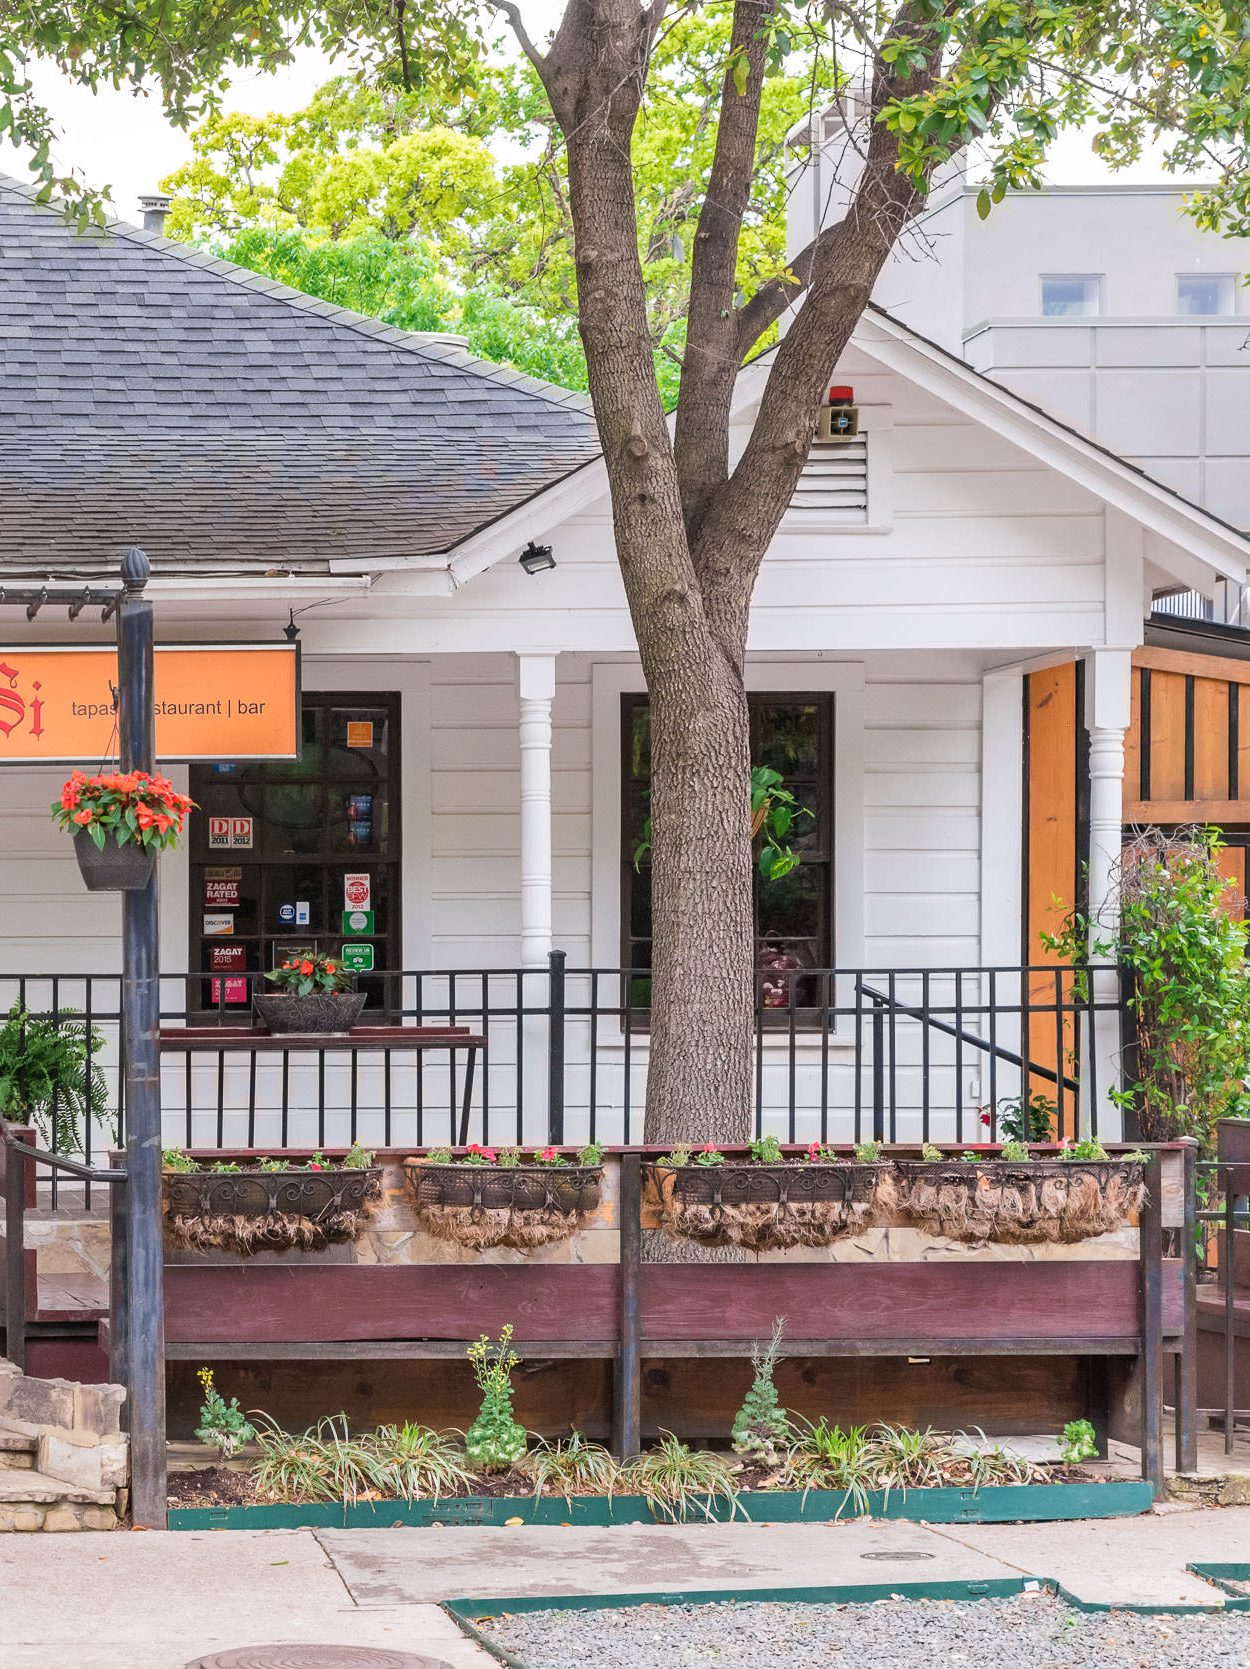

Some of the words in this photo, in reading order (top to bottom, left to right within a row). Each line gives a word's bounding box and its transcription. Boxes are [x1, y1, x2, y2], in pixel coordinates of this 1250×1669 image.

[71, 701, 119, 719] tapas
[154, 700, 222, 715] staurant
[238, 699, 266, 714] bar
[213, 820, 229, 834] D
[235, 820, 250, 834] D
[206, 882, 238, 890] ZAGAT
[206, 890, 238, 898] RATED
